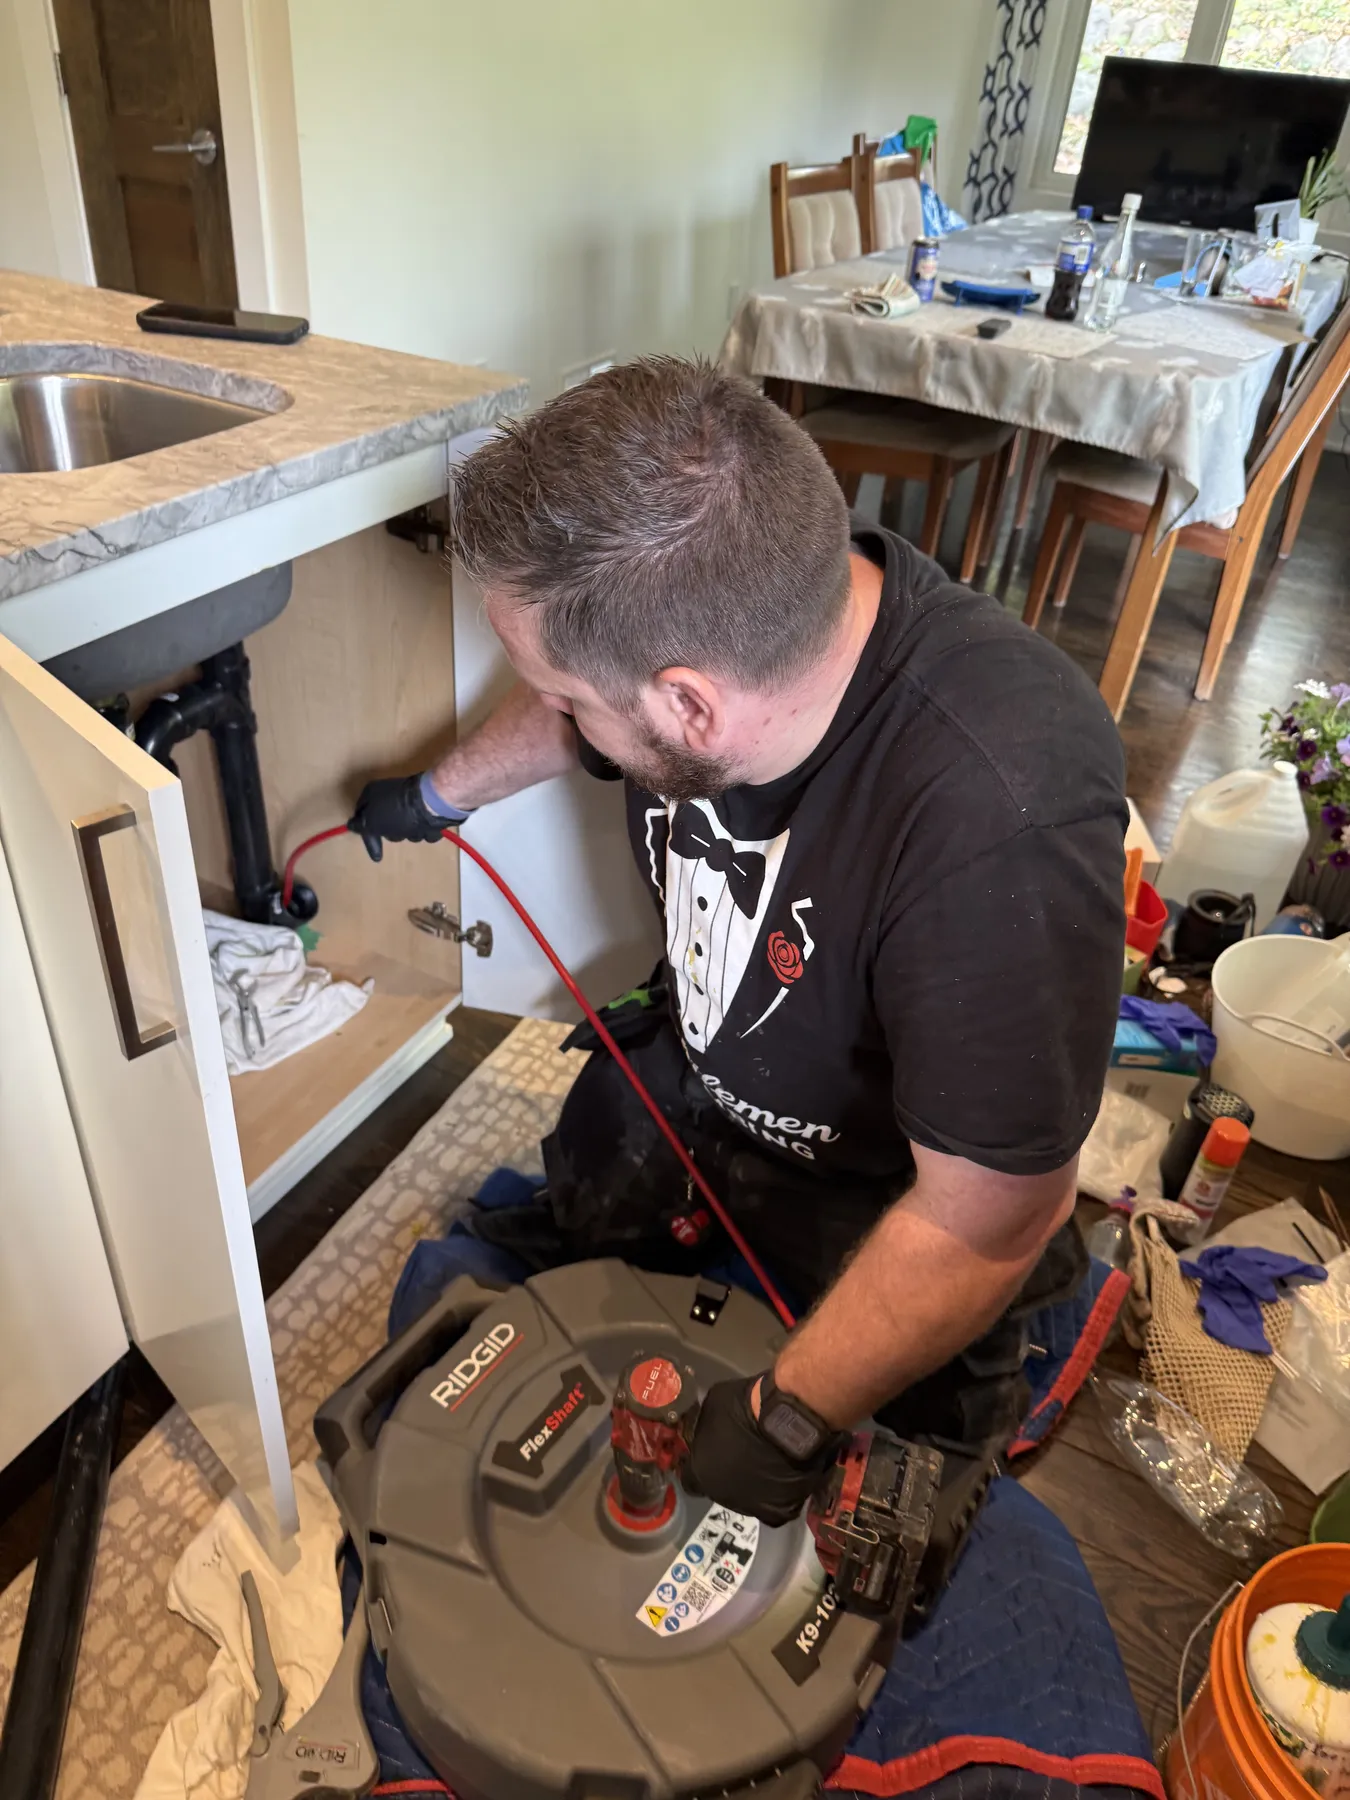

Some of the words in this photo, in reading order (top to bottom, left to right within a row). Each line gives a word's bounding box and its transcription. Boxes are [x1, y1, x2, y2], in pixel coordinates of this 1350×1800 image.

[430, 1322, 515, 1409] RIDGID
[641, 1362, 663, 1401] FUEL
[519, 1386, 585, 1462] FlexShaft
